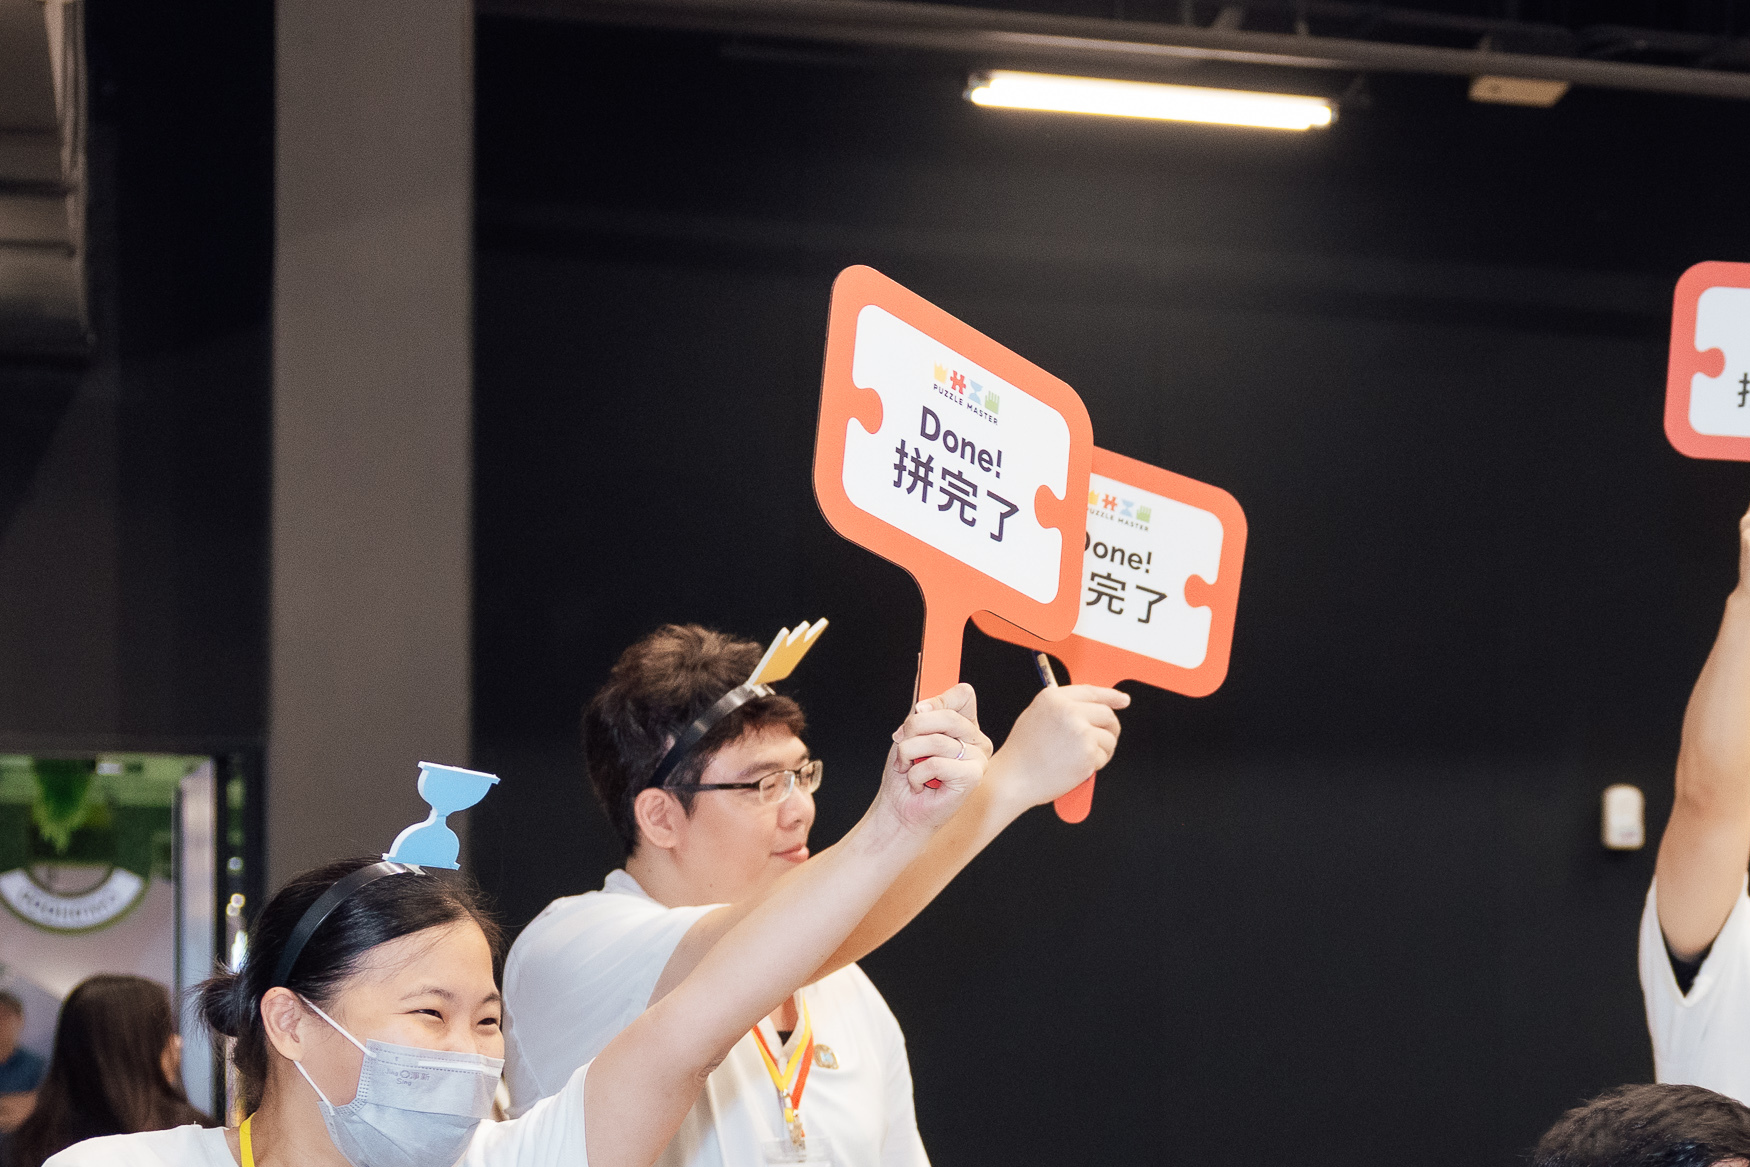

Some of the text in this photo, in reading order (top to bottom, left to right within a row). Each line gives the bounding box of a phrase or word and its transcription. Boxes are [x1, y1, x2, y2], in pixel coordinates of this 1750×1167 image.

[933, 383, 998, 425] PUZZLE MASTER
[920, 404, 1002, 480] Done!
[892, 438, 1020, 543] 拼完了
[1087, 506, 1149, 532] UZZLE MASTER
[1085, 571, 1168, 624] 完了
